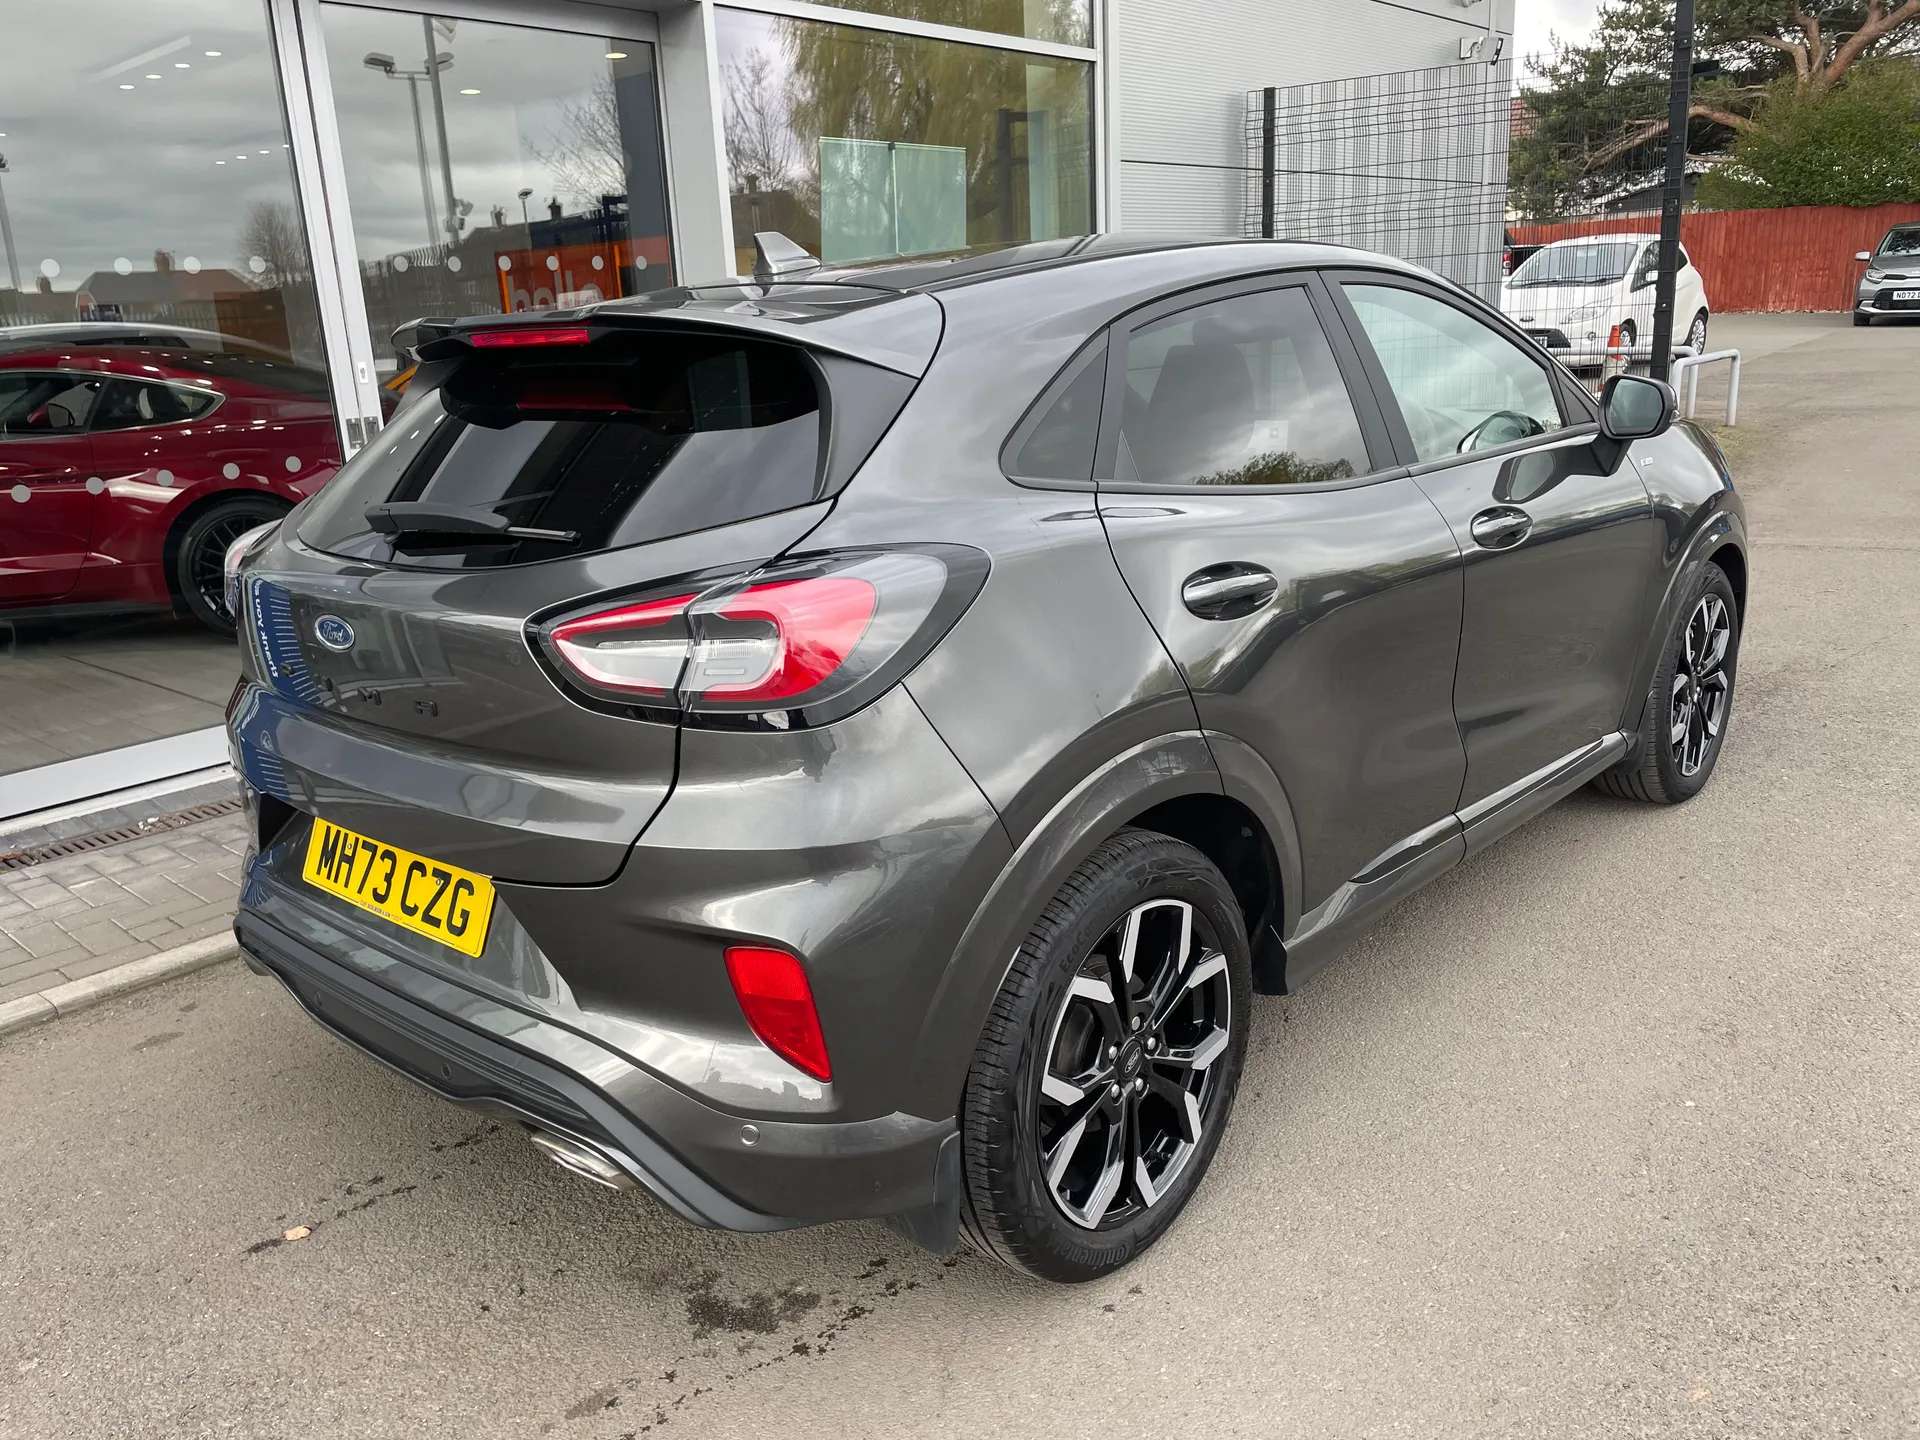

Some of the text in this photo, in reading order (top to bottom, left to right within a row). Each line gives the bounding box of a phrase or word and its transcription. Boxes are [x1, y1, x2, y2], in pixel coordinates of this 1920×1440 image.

[322, 621, 345, 643] Ford
[316, 825, 475, 937] MH73 CZG
